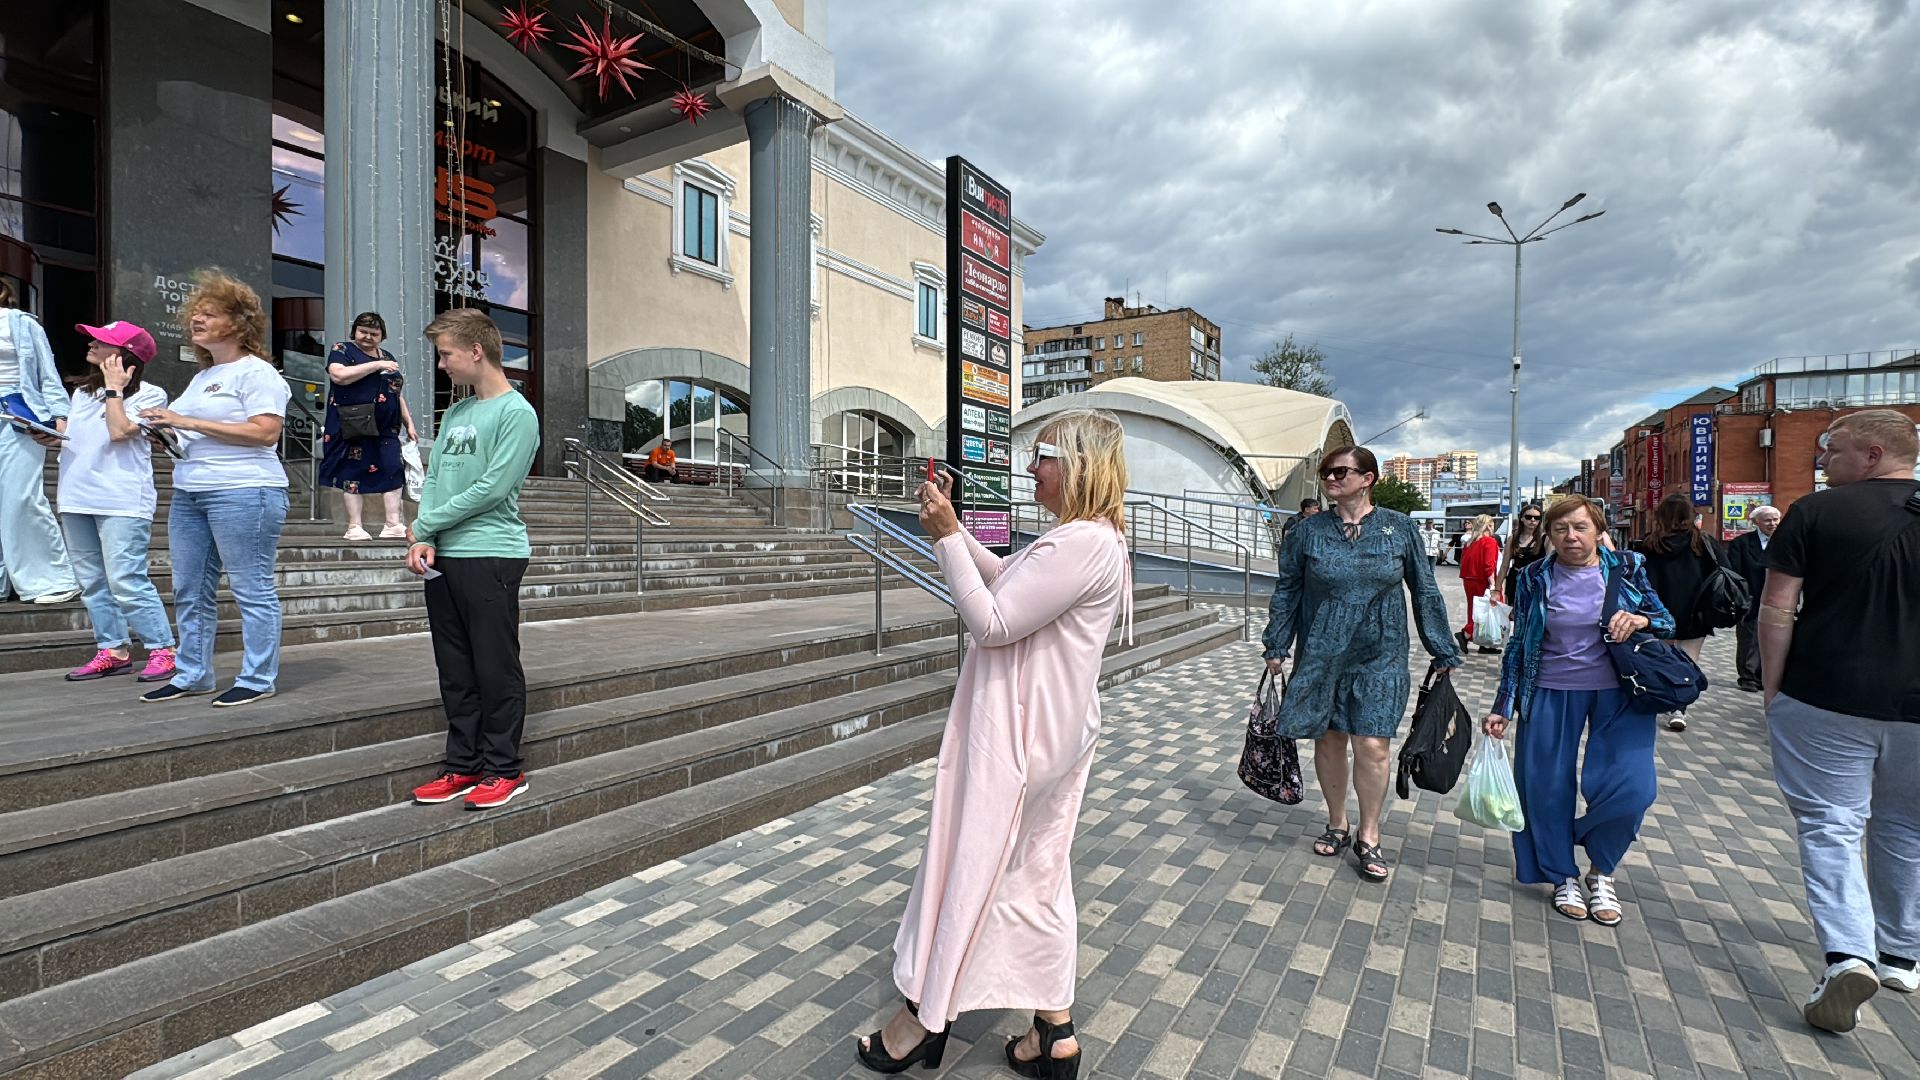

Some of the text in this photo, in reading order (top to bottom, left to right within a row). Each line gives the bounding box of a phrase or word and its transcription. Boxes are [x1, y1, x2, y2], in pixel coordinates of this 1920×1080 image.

[965, 261, 1007, 294] Леонардо
[963, 408, 984, 420] АПТЕКА
[1693, 417, 1710, 501] ЮВЕЛИРНЫЙ
